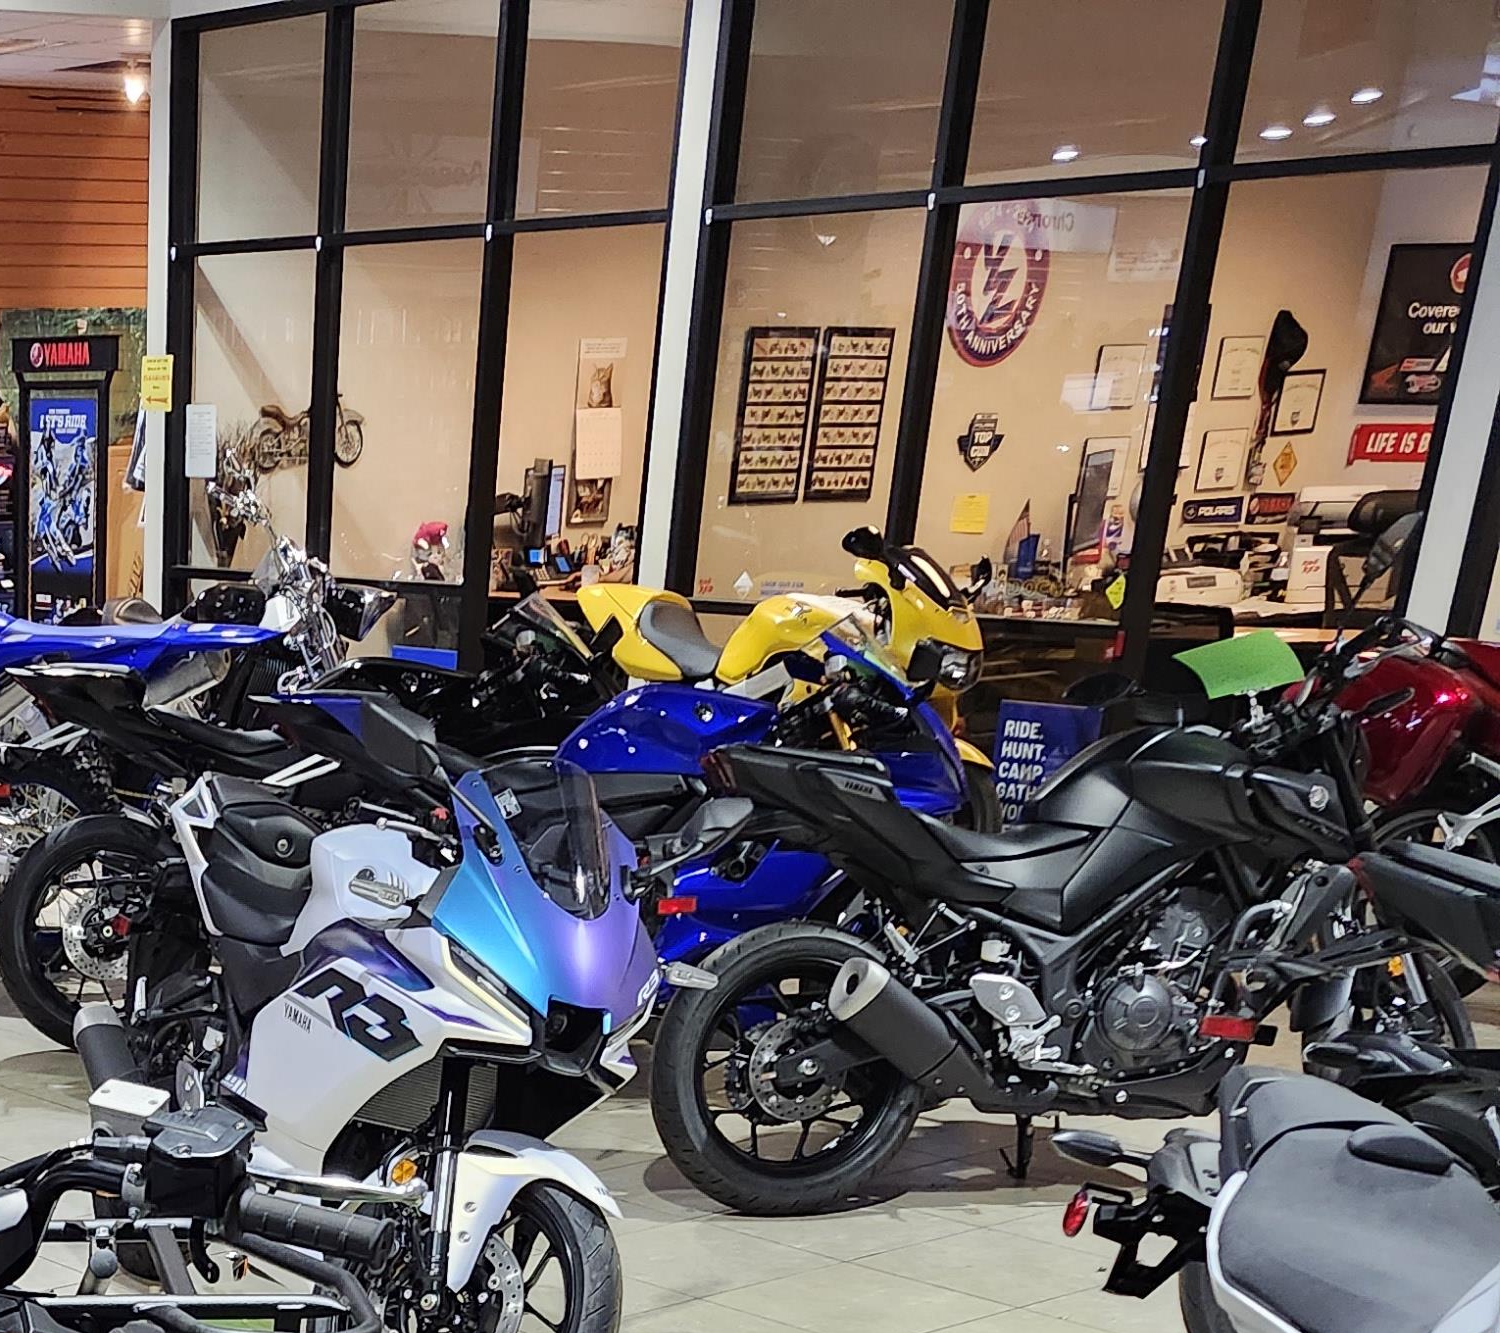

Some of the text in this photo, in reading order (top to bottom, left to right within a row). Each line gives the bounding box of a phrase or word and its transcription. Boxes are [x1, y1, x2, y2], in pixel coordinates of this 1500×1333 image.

[965, 282, 1042, 356] ANNIVERSARY
[1423, 323, 1448, 334] our
[44, 341, 90, 367] YAMAHA
[973, 431, 994, 443] TOP
[1366, 432, 1398, 454] LIFE
[1399, 432, 1415, 454] IS
[1198, 504, 1237, 517] POLARIS
[1004, 720, 1044, 740] RIDE.
[1001, 741, 1046, 762] HUNT.
[998, 761, 1046, 782] CAMP.
[995, 782, 1037, 801] GATH
[283, 1002, 312, 1034] YAMAHA
[294, 966, 423, 1062] R3
